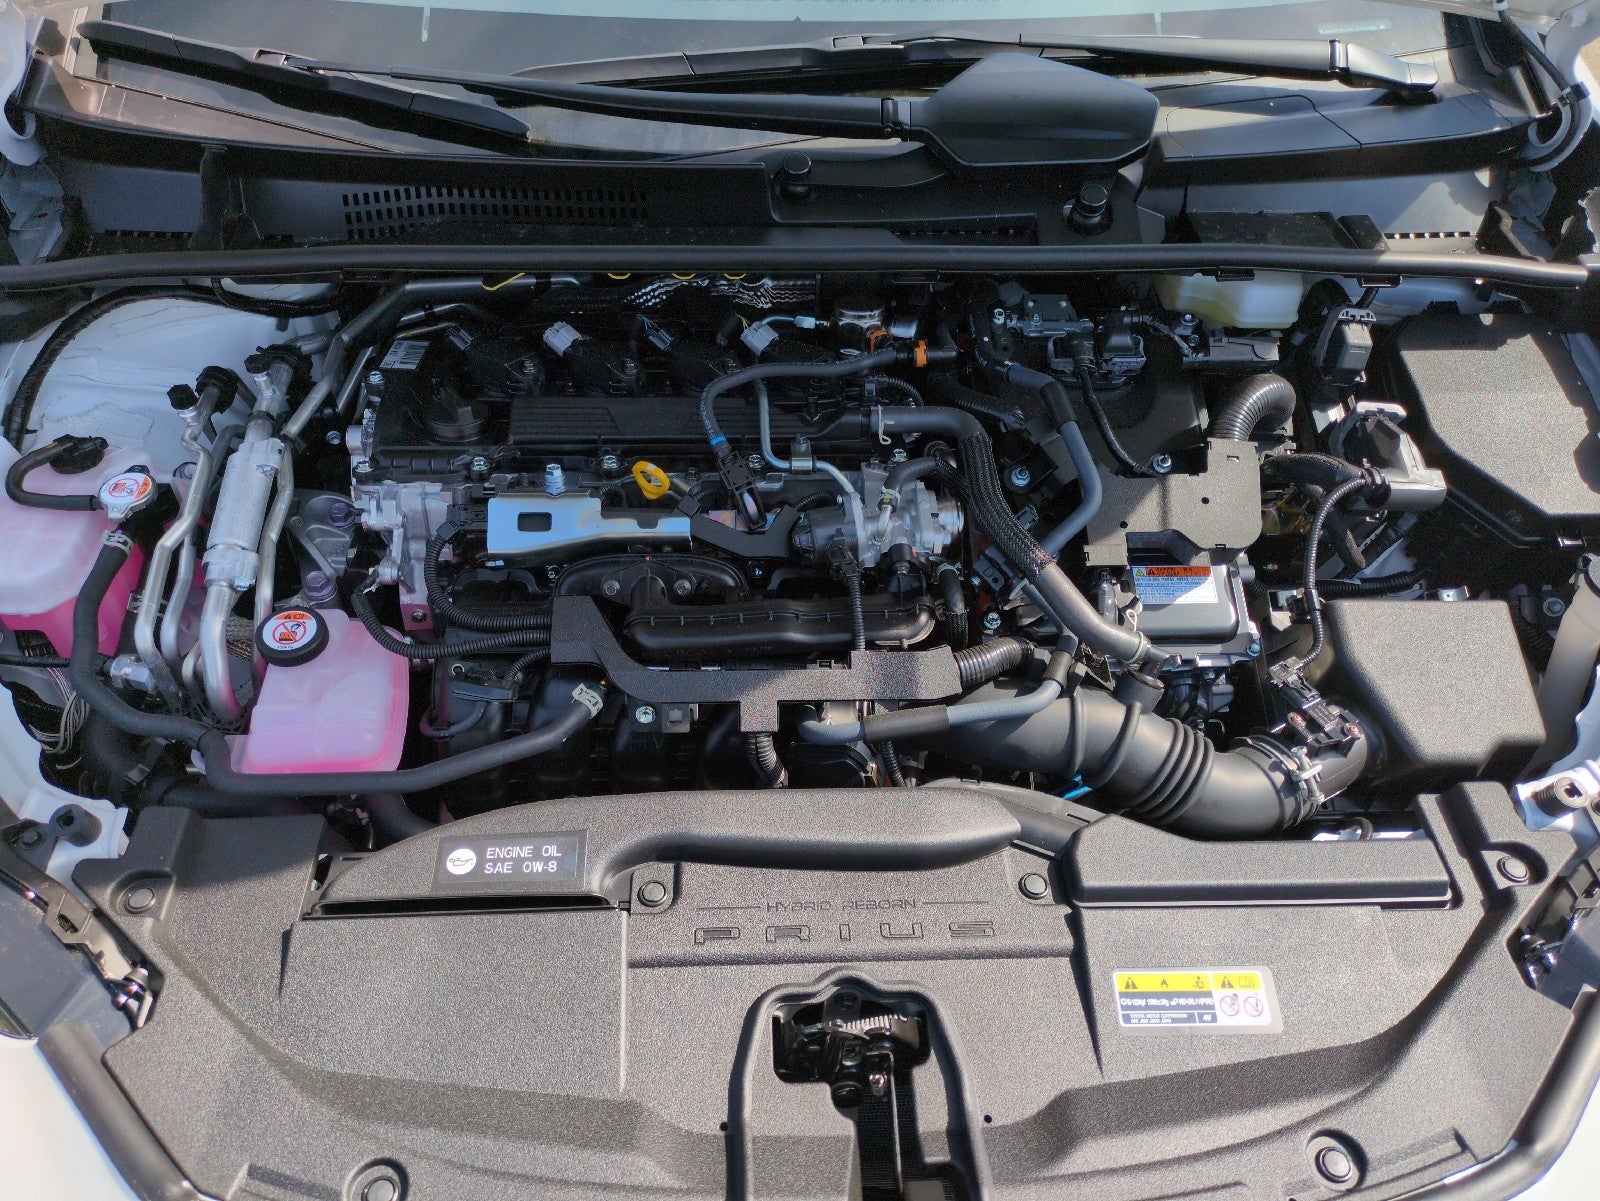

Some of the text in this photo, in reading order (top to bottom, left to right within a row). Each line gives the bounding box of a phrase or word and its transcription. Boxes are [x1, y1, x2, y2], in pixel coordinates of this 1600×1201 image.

[486, 845, 562, 859] ENGINE OIL
[484, 861, 558, 874] SAE 0W-8
[766, 898, 917, 912] HYBRID REBORN
[693, 921, 996, 945] PRIUS
